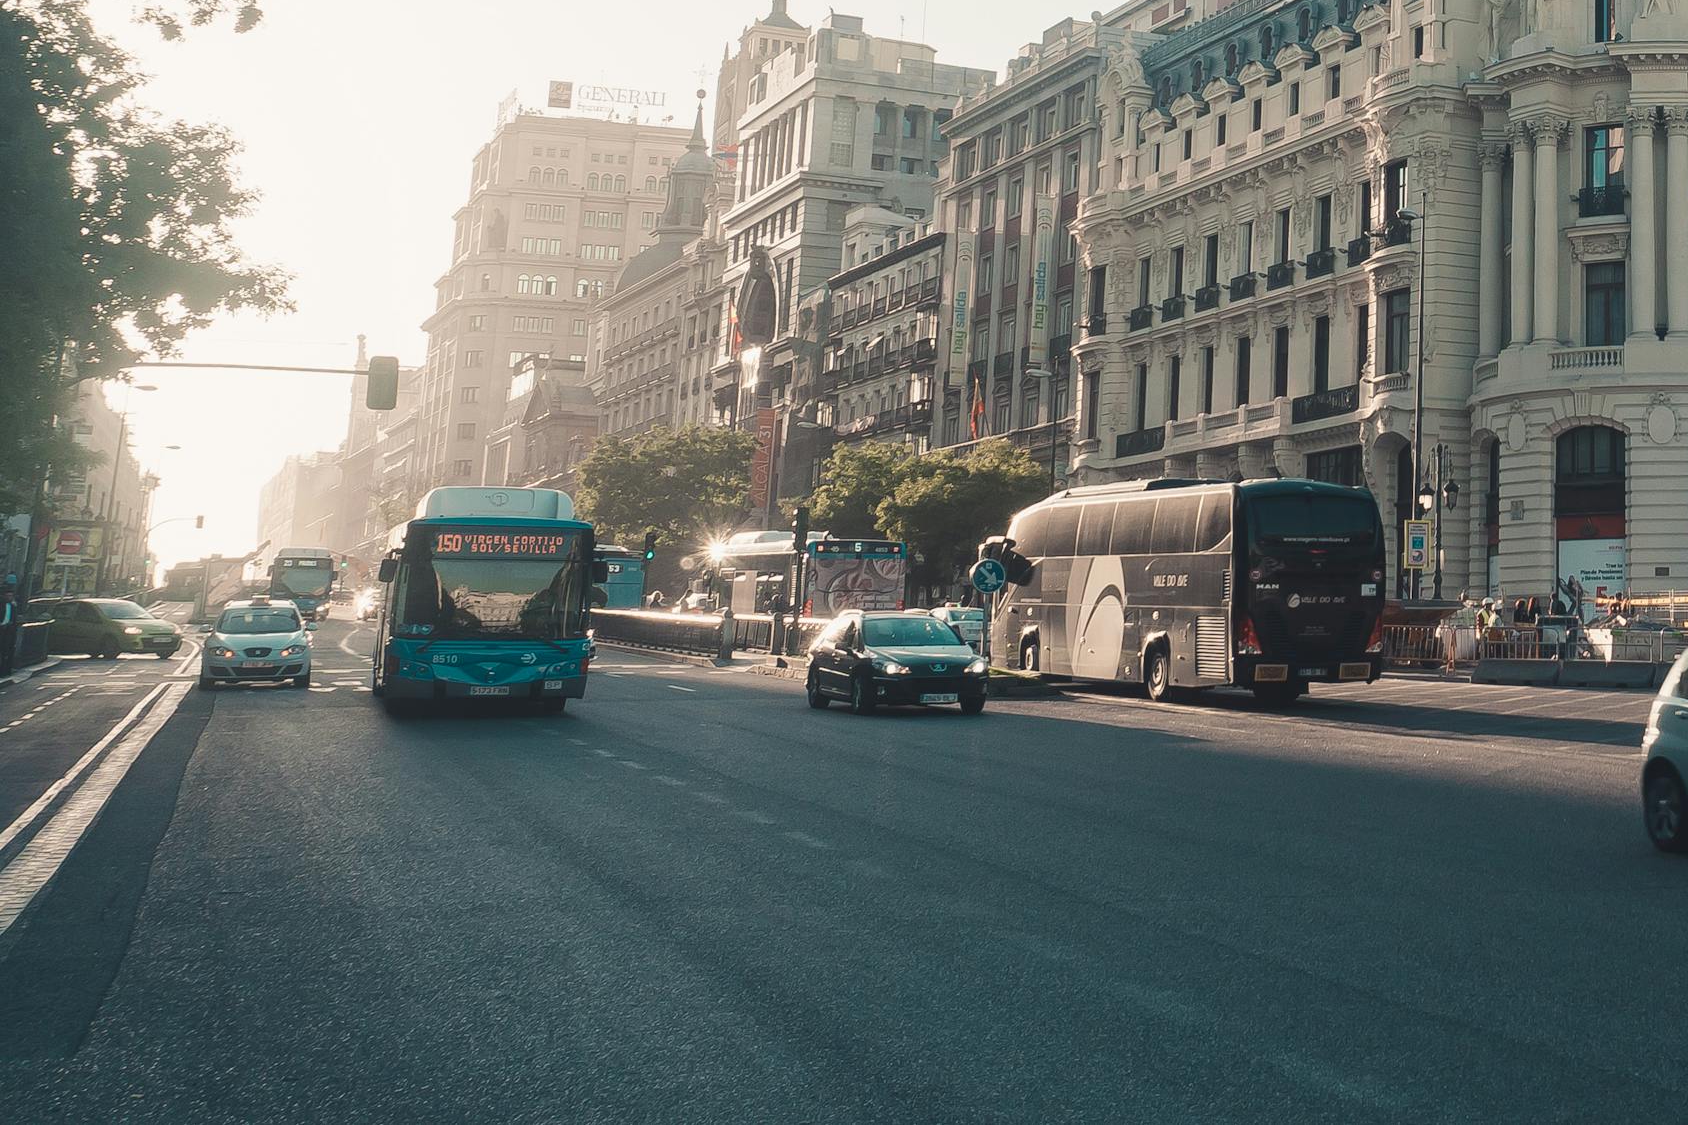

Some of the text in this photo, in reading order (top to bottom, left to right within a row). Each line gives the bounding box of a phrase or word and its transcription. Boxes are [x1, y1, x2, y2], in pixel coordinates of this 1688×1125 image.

[578, 84, 667, 106] GENERALI
[1035, 261, 1047, 301] salida
[952, 291, 967, 355] hay salida
[1033, 303, 1048, 330] hay
[759, 424, 773, 439] 31
[436, 534, 462, 553] 150
[464, 534, 564, 546] VIRGEN CORTIJO
[470, 543, 557, 554] SOL/SEVILLA
[854, 542, 862, 552] 5
[608, 564, 621, 573] 53
[1153, 574, 1167, 587] VALE
[1166, 574, 1177, 587] DO
[1301, 596, 1318, 604] VALE
[432, 654, 458, 664] 8510
